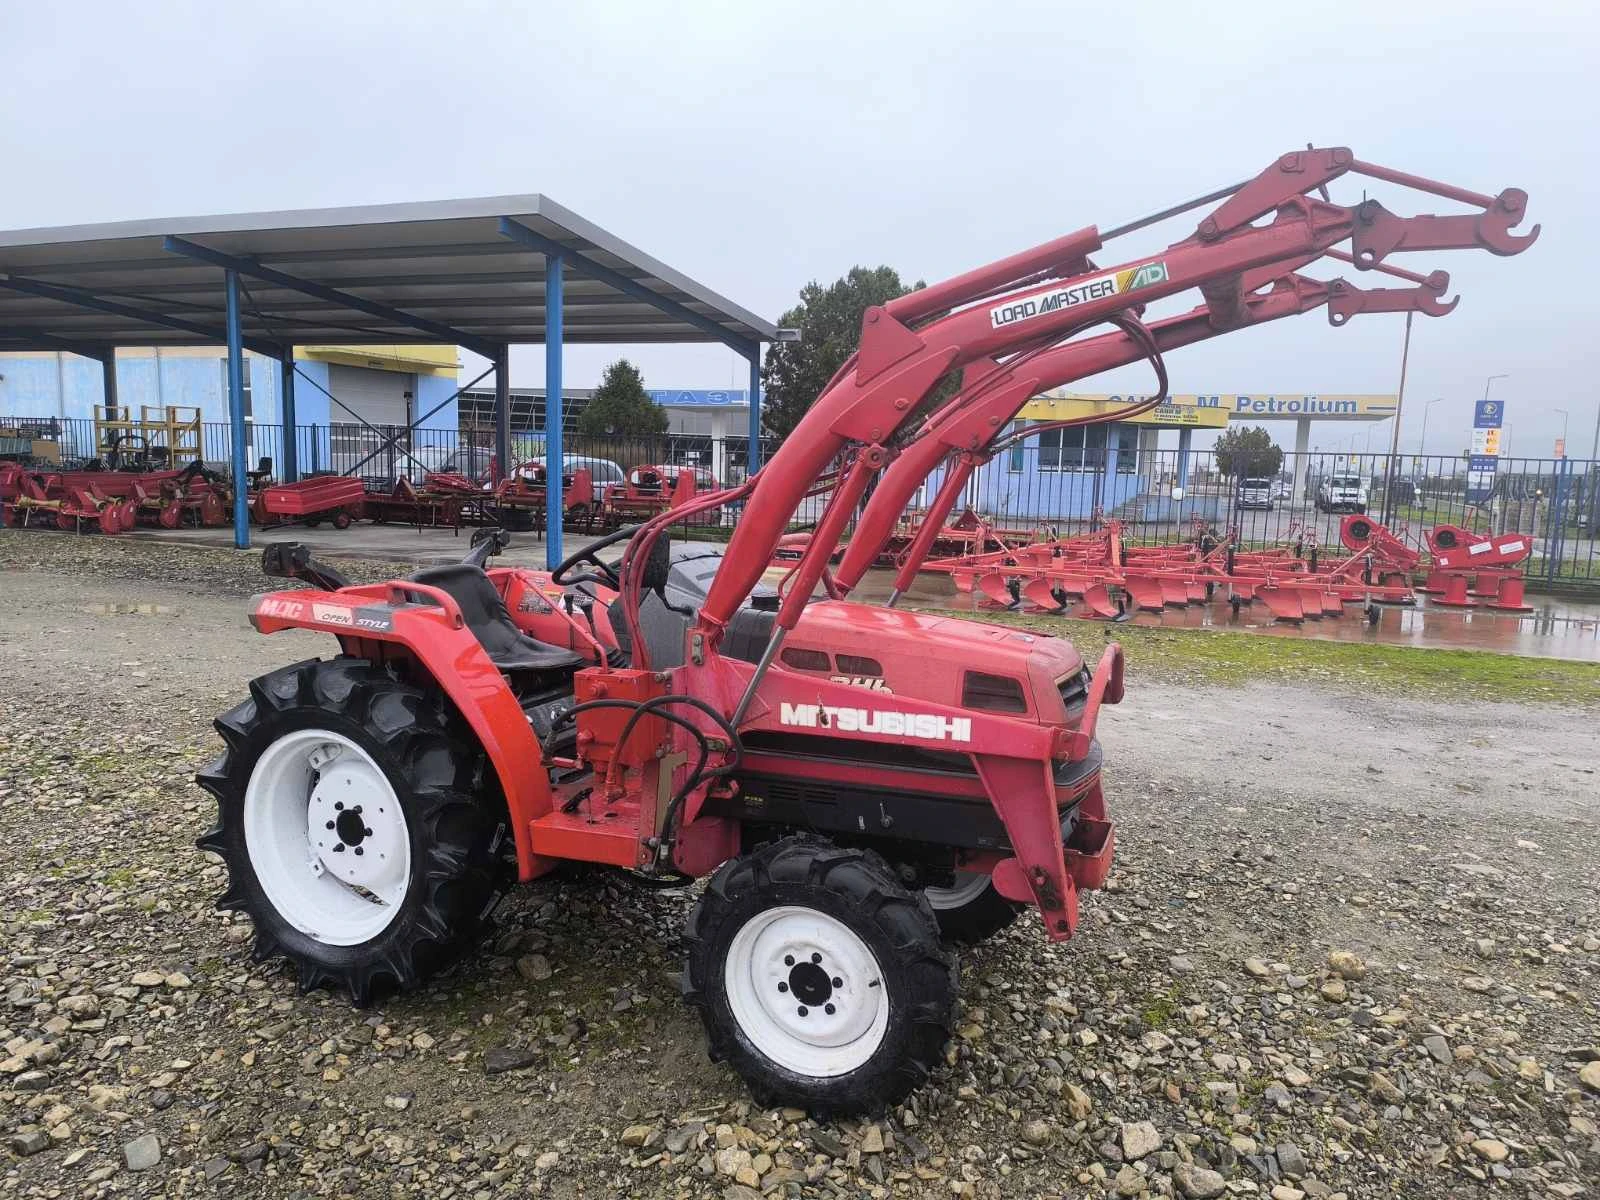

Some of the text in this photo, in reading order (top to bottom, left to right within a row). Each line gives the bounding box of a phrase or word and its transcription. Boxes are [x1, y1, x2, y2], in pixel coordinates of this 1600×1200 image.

[1039, 279, 1114, 313] MASTER
[1236, 396, 1358, 413] Petrolium
[321, 612, 389, 629] OPEN STYLE
[780, 702, 972, 742] MITSUBISHI
